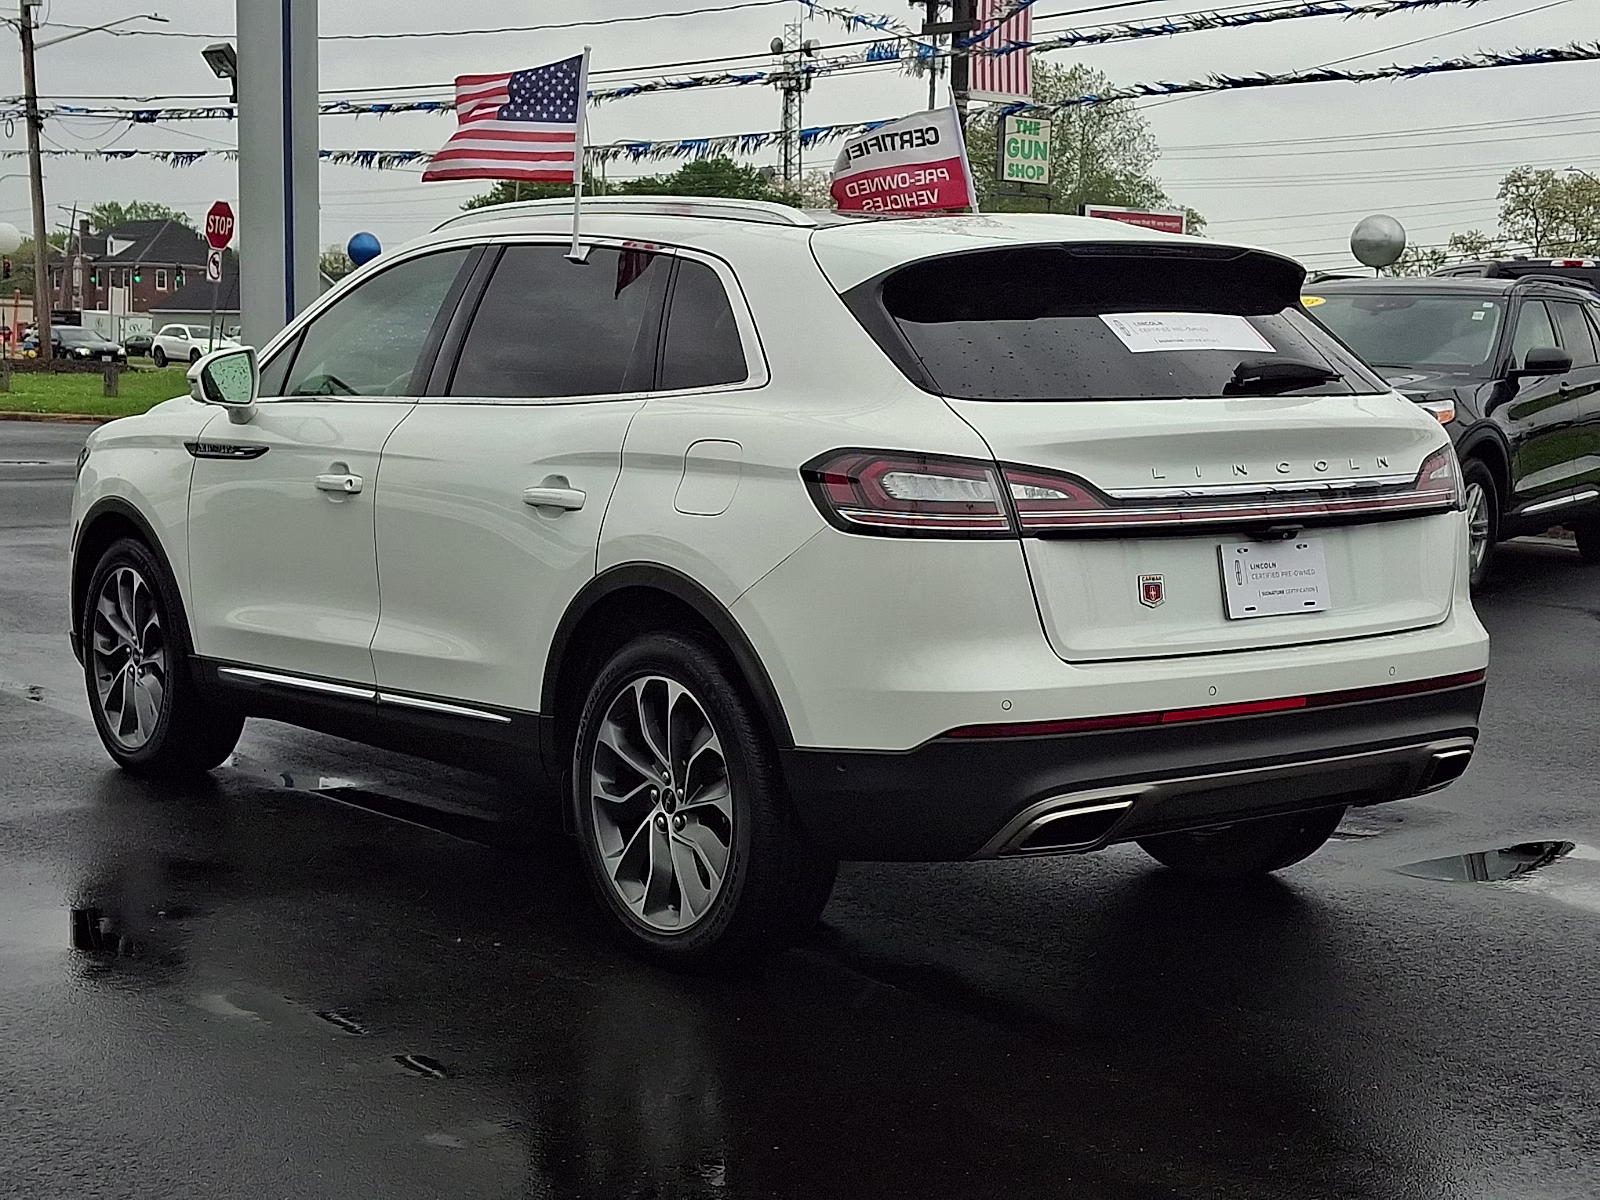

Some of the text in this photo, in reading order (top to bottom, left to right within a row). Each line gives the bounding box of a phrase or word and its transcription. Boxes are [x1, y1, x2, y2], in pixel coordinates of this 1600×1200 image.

[1015, 119, 1041, 136] THE
[1007, 137, 1048, 161] GUN
[1007, 163, 1045, 180] SHOP
[207, 215, 233, 236] STOP
[1152, 457, 1389, 480] LINCOLN
[1250, 562, 1277, 570] LINCOLN
[1251, 569, 1316, 580] CERTIFIED PRE-OWNED
